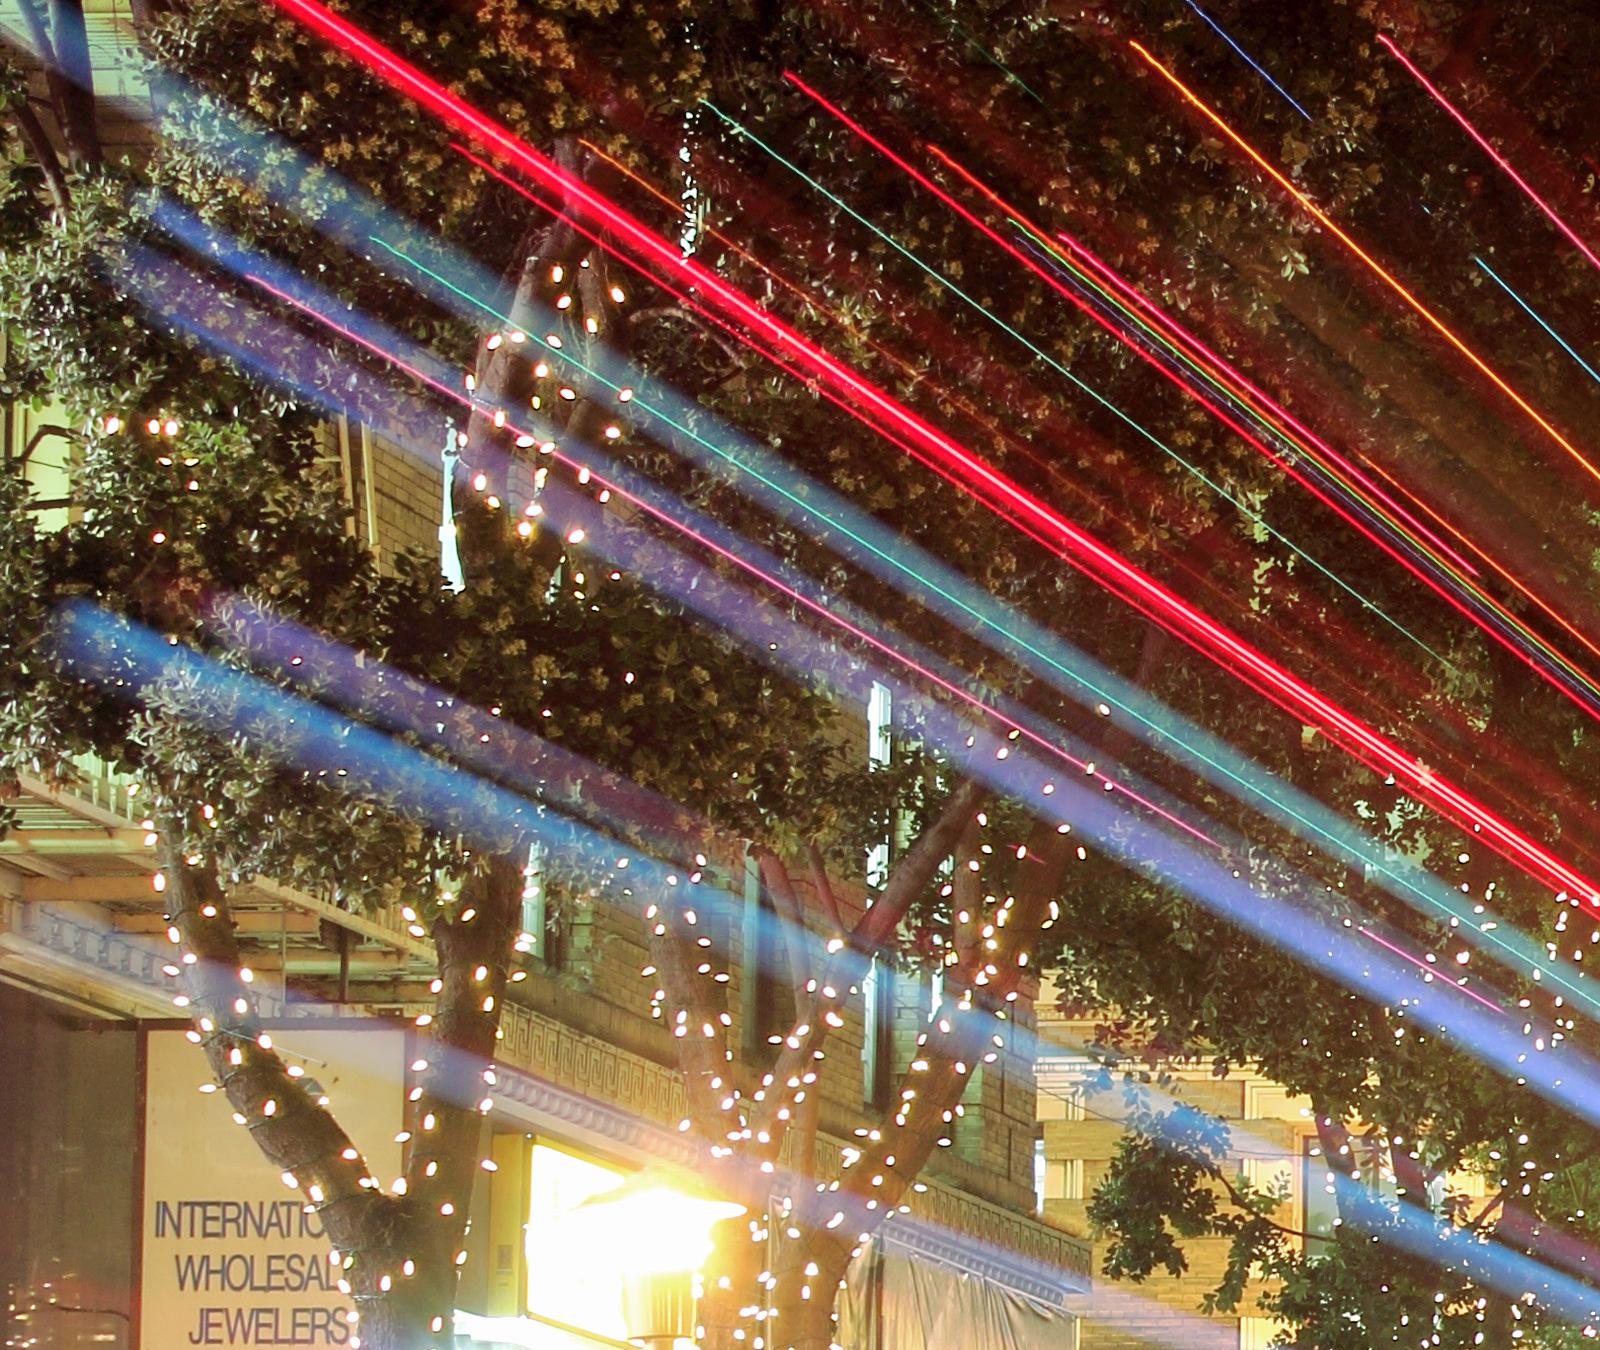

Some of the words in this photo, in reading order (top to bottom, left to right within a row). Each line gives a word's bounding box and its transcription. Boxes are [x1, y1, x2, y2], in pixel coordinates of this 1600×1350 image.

[155, 1200, 327, 1239] INTERNATIO
[175, 1254, 340, 1292] WHOLESAL
[188, 1307, 350, 1345] JEWELERS
